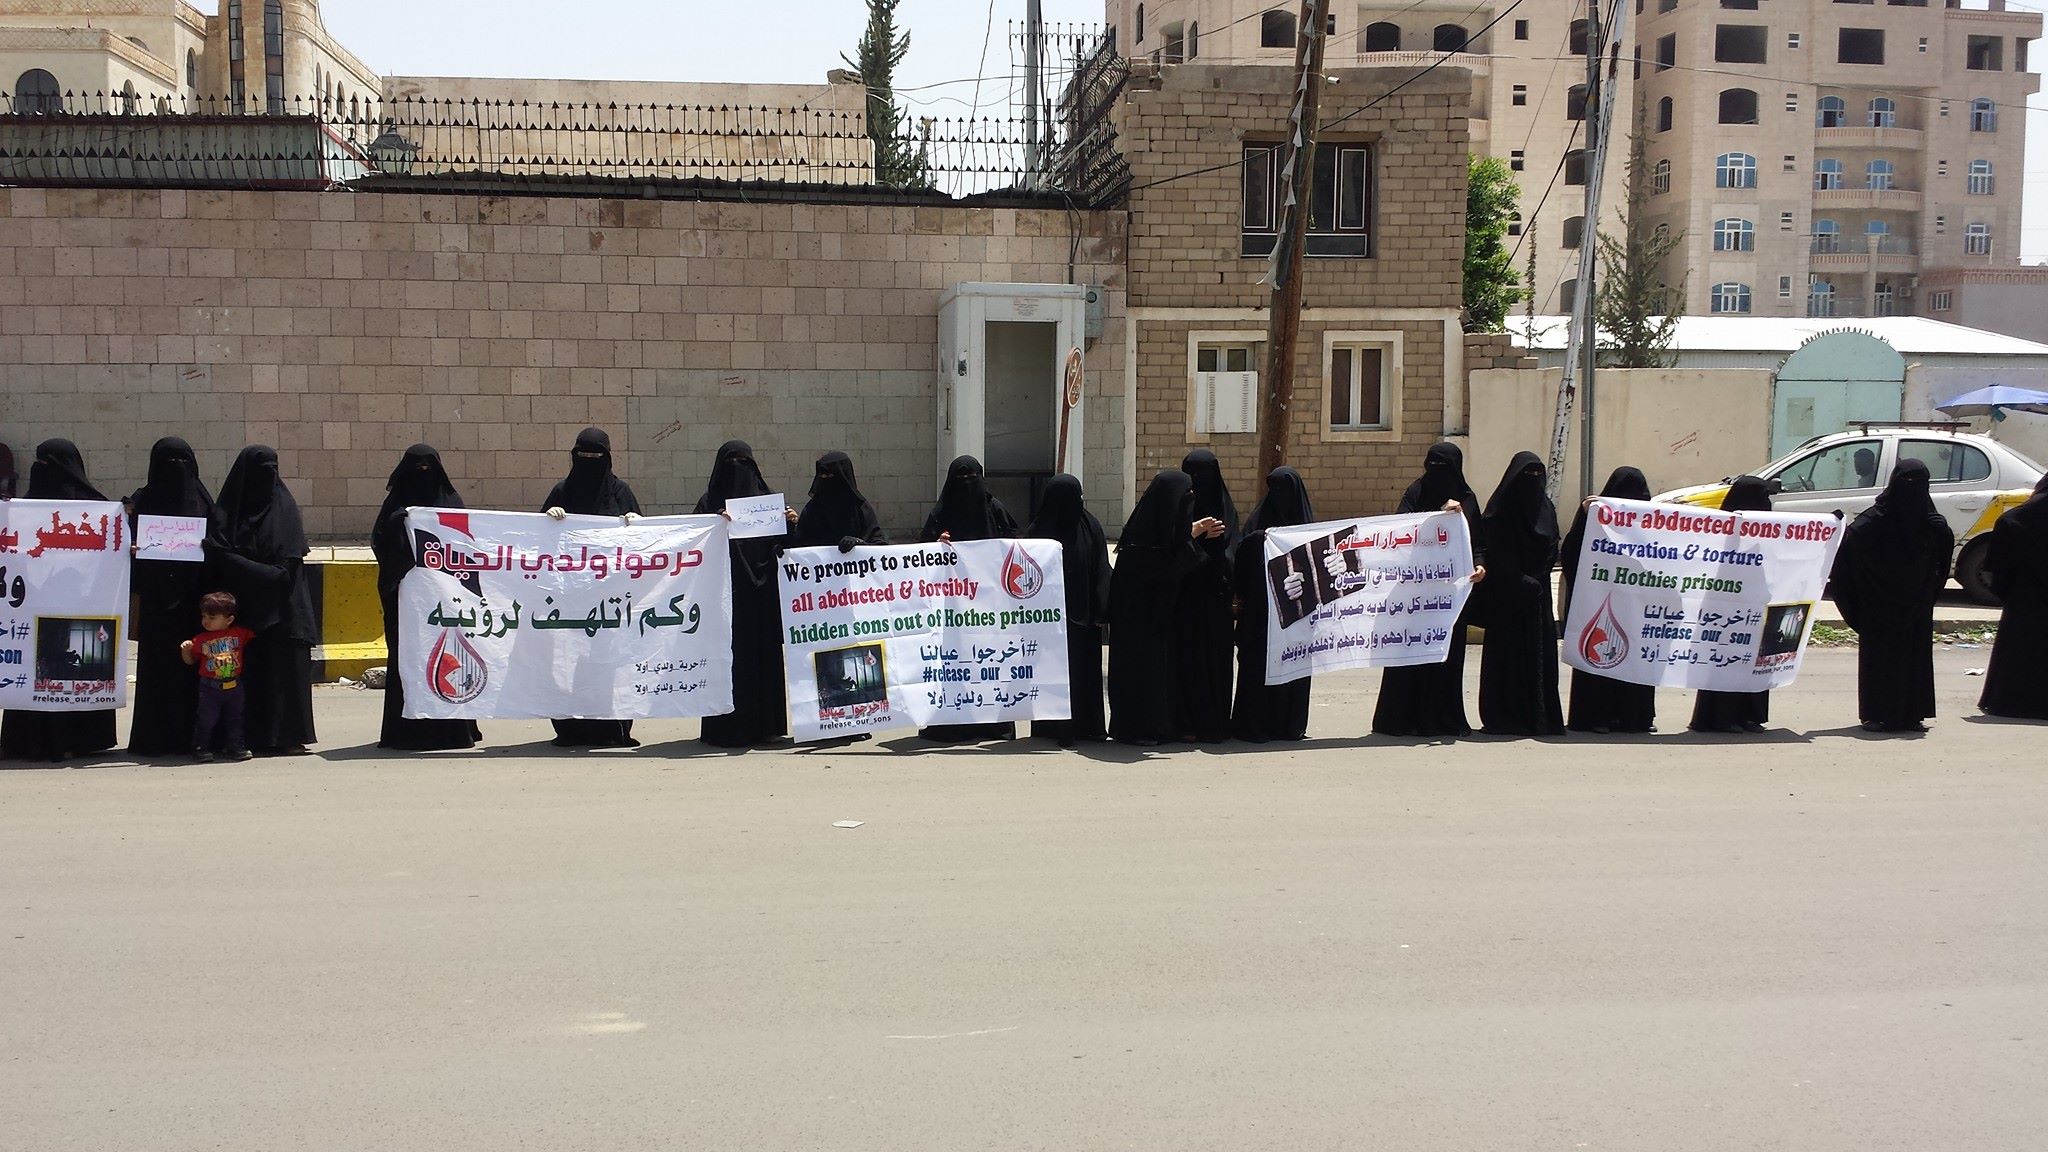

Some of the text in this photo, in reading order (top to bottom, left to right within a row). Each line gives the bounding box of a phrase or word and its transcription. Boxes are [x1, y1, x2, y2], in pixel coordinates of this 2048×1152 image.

[27, 510, 123, 558] الخطر
[1436, 526, 1448, 546] يا
[1597, 504, 1638, 527] Our
[1641, 509, 1736, 535] abducted
[1740, 520, 1781, 538] sons
[423, 541, 704, 580] حرموا ولدي الحياة
[783, 549, 958, 583] We prompt to release
[1591, 537, 1763, 566] starvation & torture
[1591, 563, 1743, 593] in Hothies prisons
[791, 592, 814, 613] all
[818, 582, 896, 610] abducted
[900, 580, 914, 600] &
[919, 577, 979, 600] forcibly
[1389, 600, 1404, 616] من
[1407, 596, 1421, 614] كل
[427, 597, 522, 639] لرؤيته
[639, 593, 701, 638] وكم
[789, 605, 1061, 644] hidden sons out of Hothes prisons
[1641, 623, 1752, 646] #release_our_son
[923, 664, 1033, 684] #release_our_son
[33, 695, 116, 705] #release_our_sons
[819, 715, 892, 730] #release_our_sons
